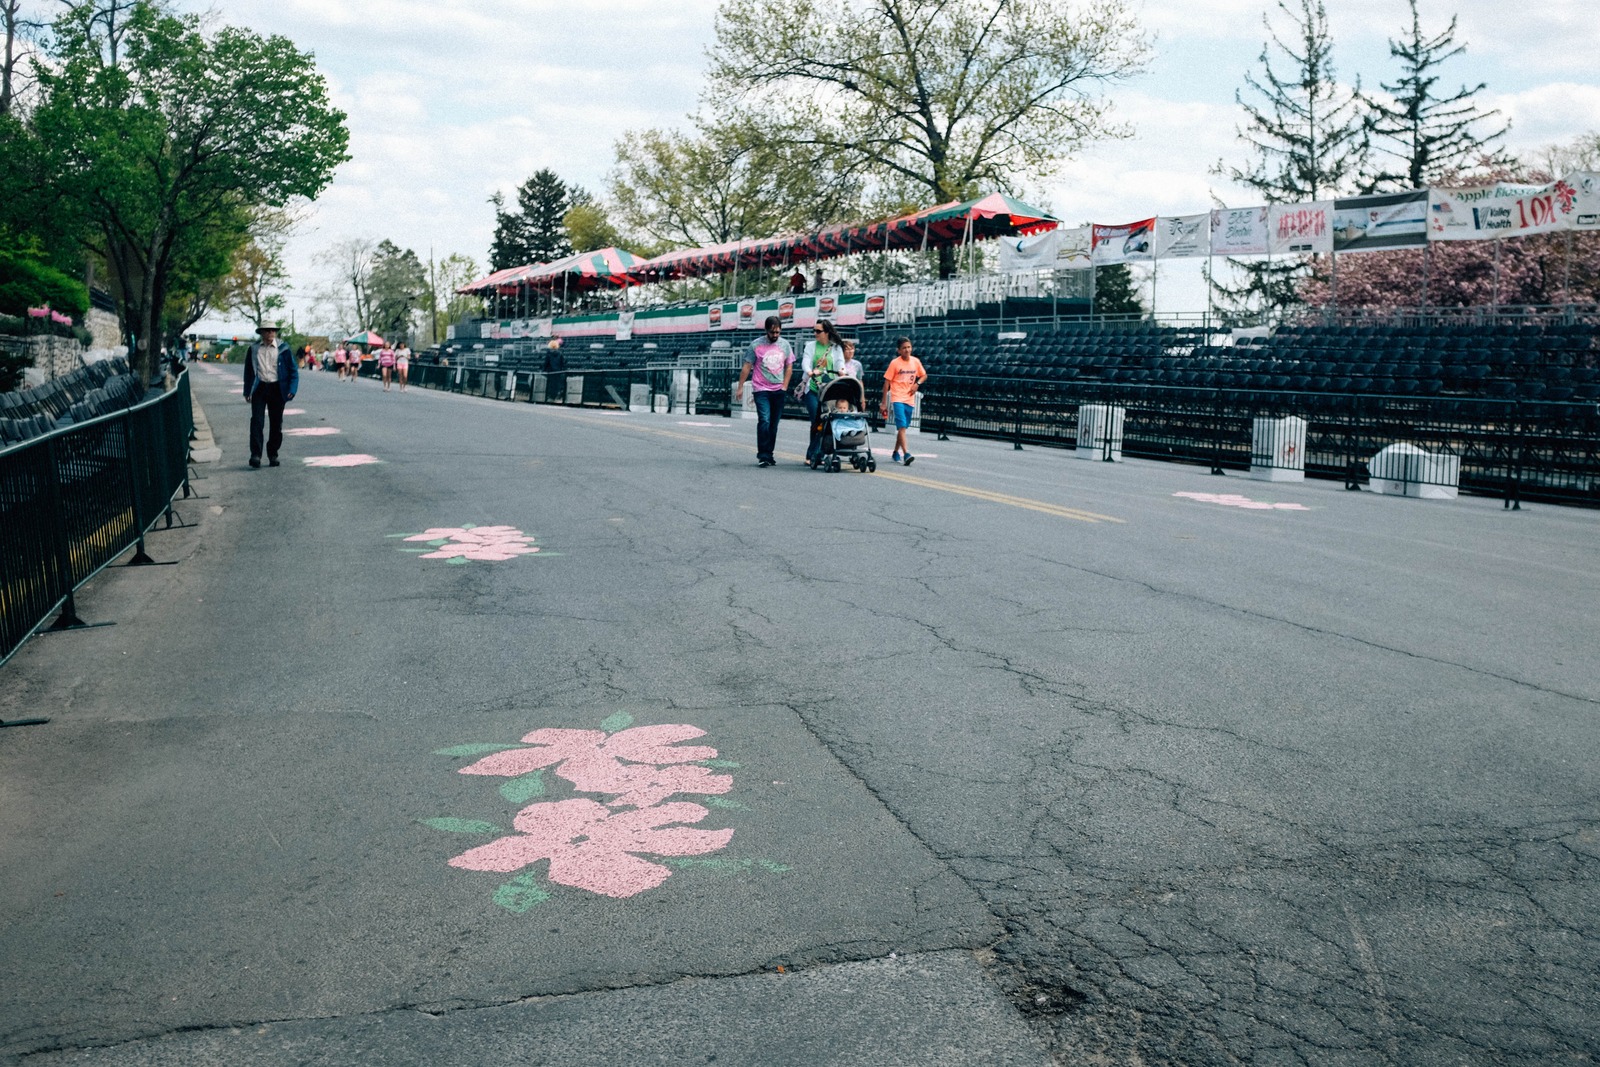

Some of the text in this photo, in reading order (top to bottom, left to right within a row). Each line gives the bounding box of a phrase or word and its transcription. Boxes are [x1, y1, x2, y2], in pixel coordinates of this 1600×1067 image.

[1456, 189, 1492, 203] Apple
[1490, 207, 1512, 218] Valley
[1516, 195, 1557, 229] 10K
[1486, 219, 1512, 230] Health
